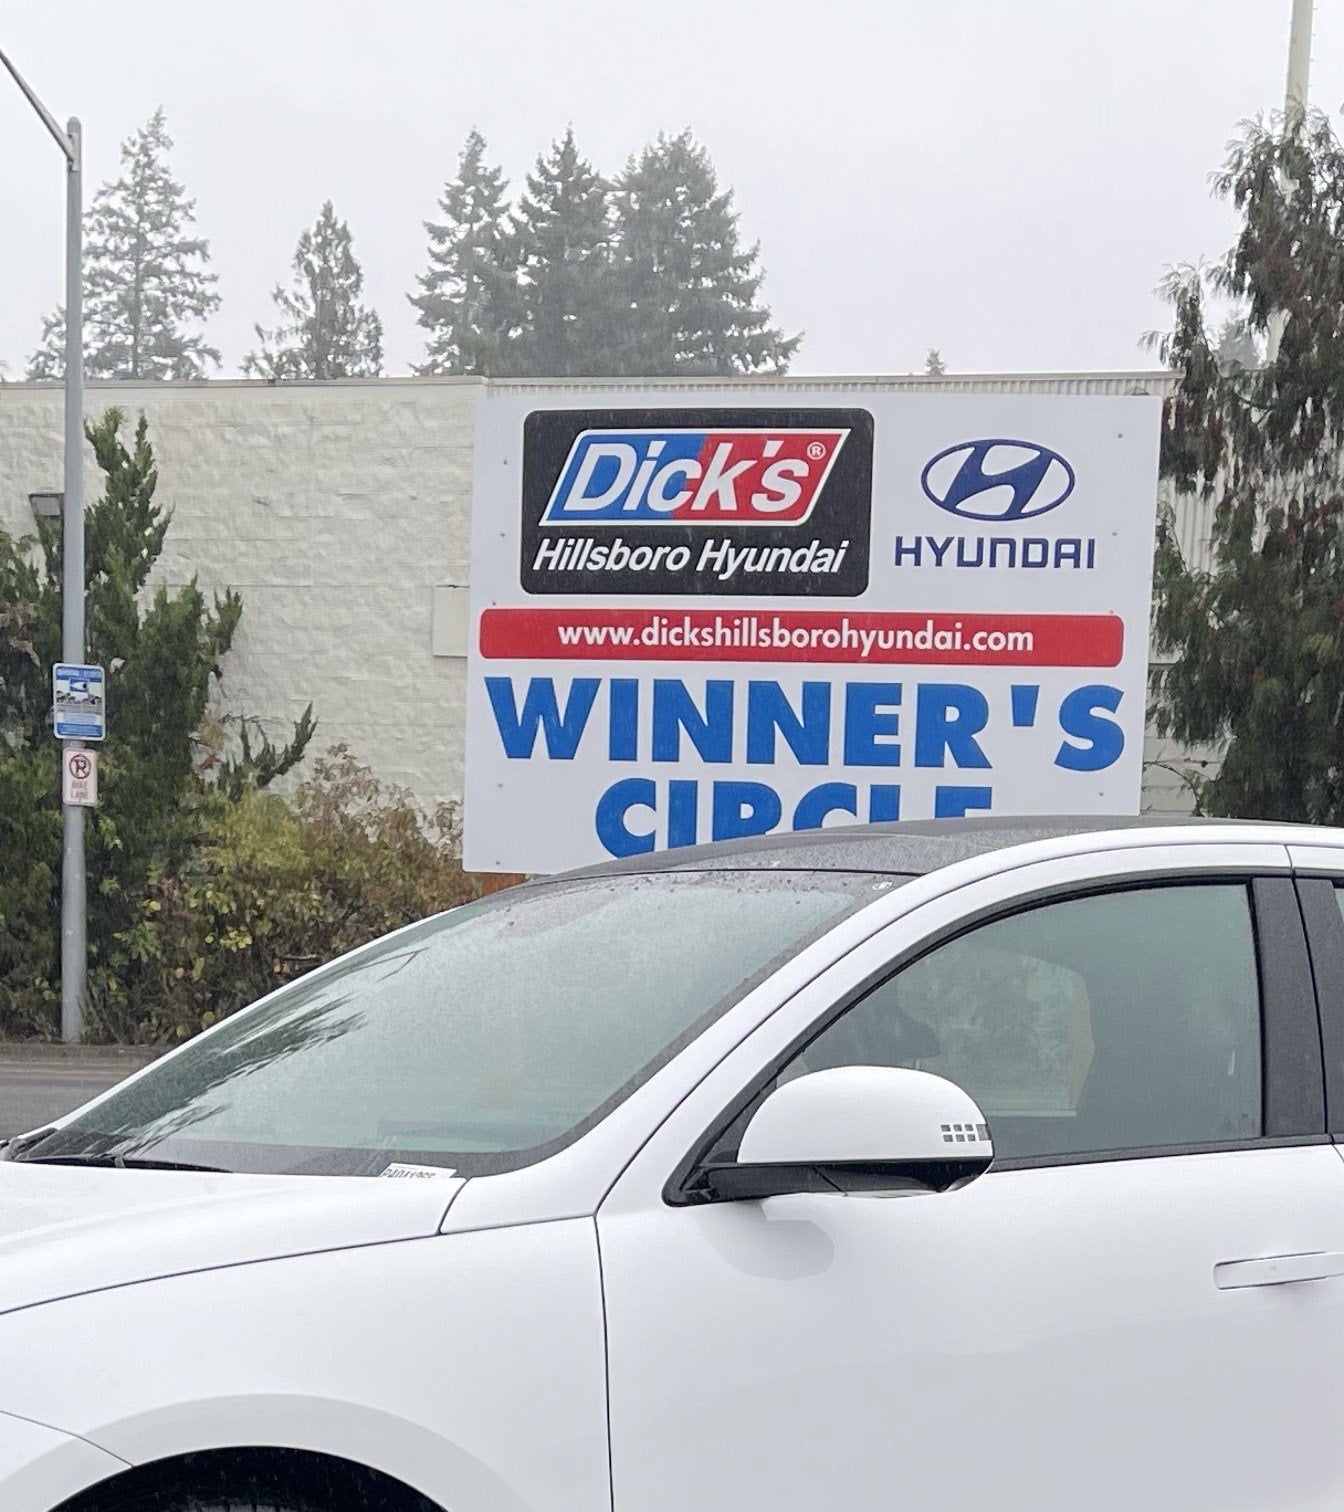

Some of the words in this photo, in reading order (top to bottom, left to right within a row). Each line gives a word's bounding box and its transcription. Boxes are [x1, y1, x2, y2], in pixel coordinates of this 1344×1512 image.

[532, 538, 689, 572] Hillsboro
[695, 539, 850, 580] Hyundai
[894, 535, 1096, 569] HYUNDAI
[557, 615, 1034, 655] www.dickshillsborohyundai.com
[484, 676, 1125, 772] WINNER'S
